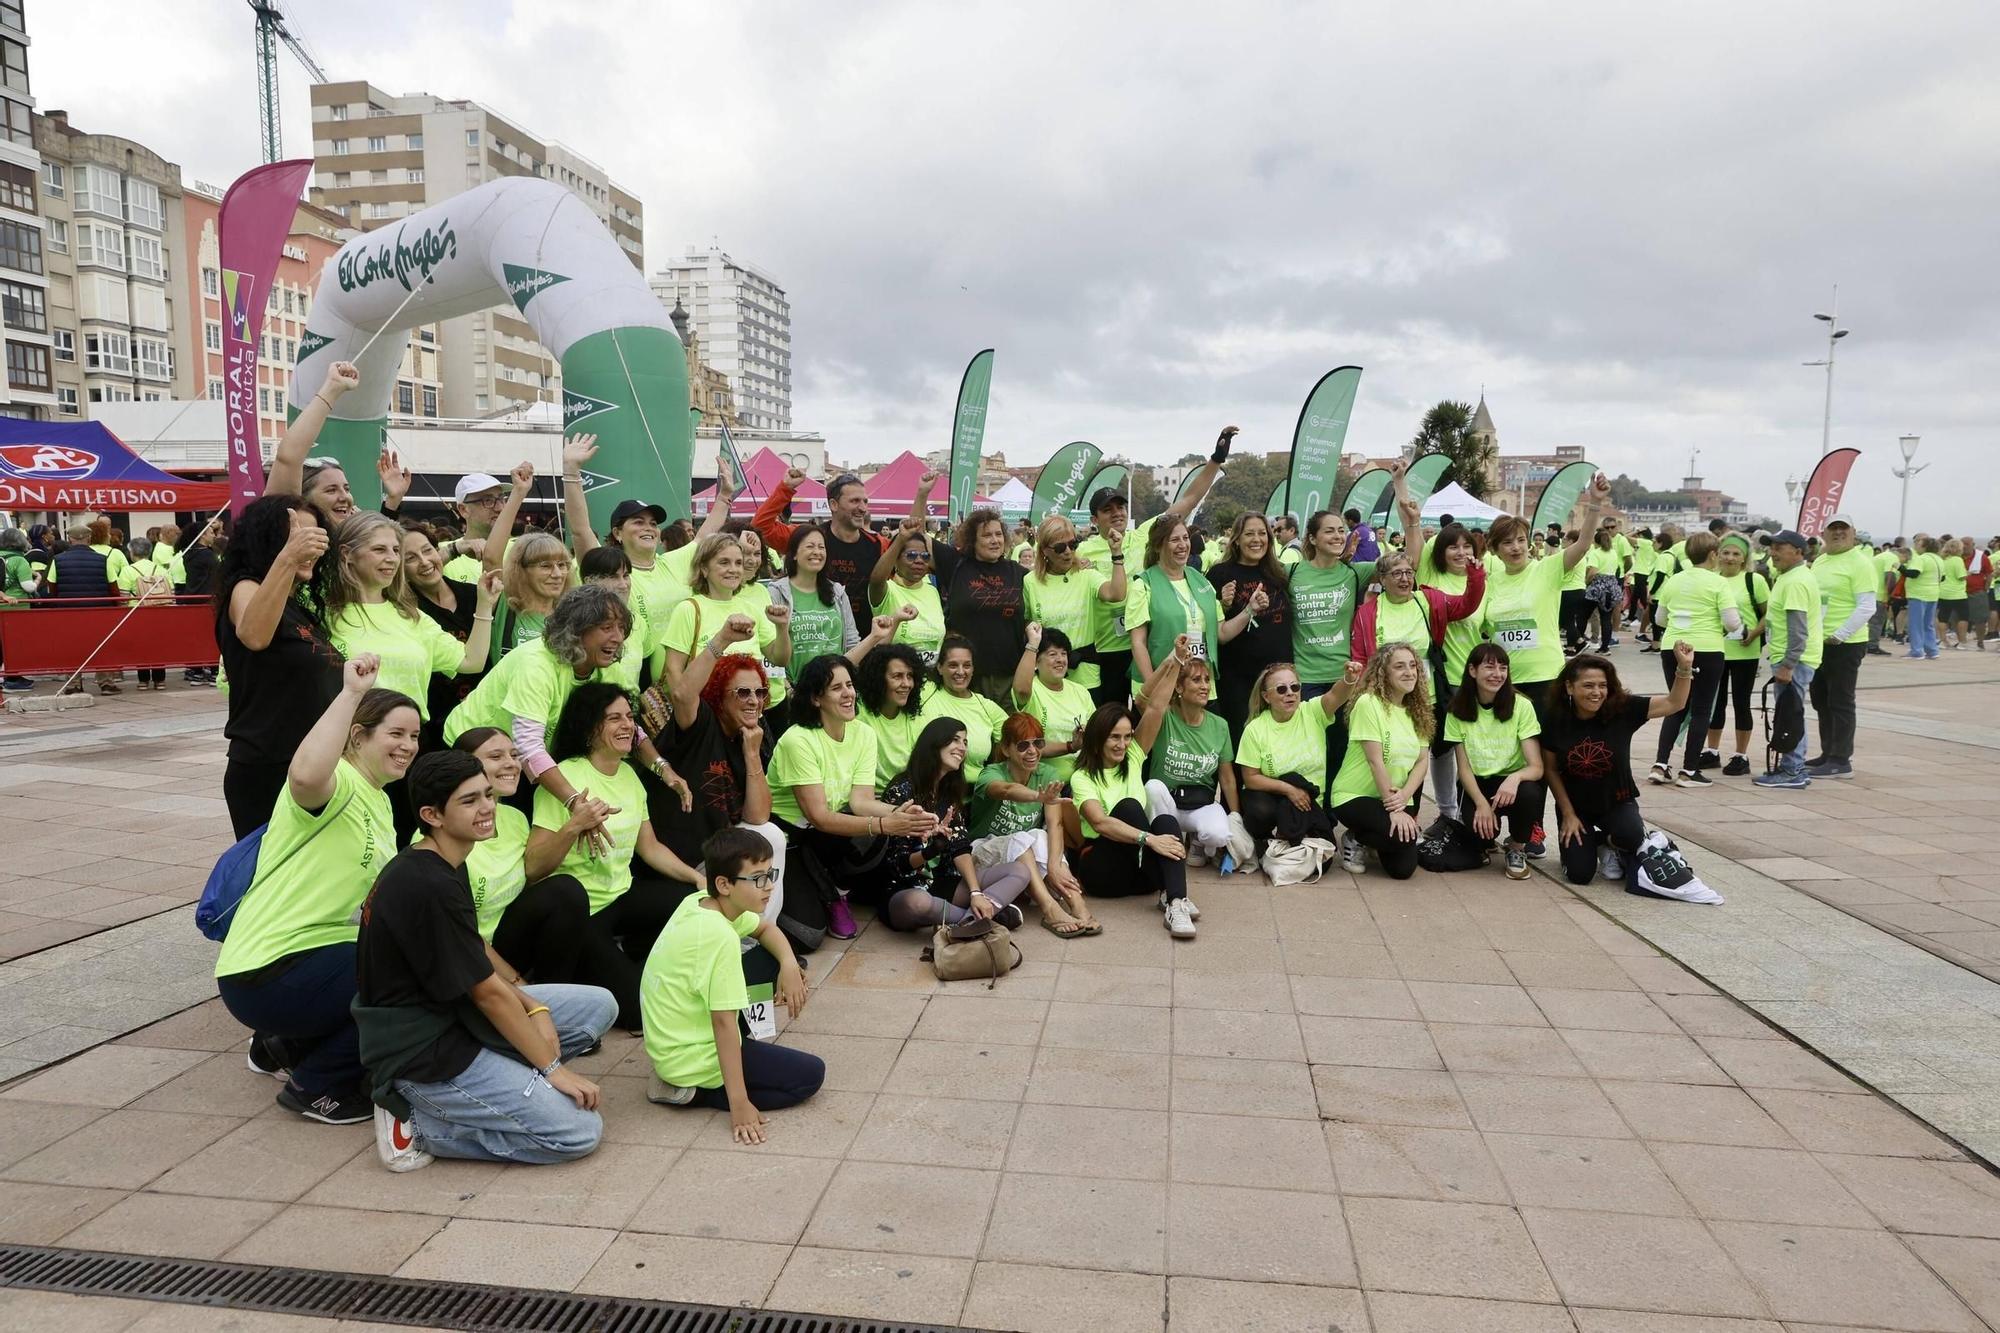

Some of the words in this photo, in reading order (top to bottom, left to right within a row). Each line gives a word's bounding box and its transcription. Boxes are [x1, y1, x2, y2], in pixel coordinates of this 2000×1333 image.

[338, 250, 356, 293] El
[354, 246, 394, 287] Corte
[395, 217, 457, 292] Inglés
[243, 349, 255, 415] kutxa
[56, 489, 177, 505] ATLETISMO
[1297, 601, 1326, 610] contra
[1306, 608, 1339, 618] cáncer
[791, 623, 817, 632] contra
[1501, 630, 1531, 642] 1052
[1167, 745, 1179, 758] En
[1164, 757, 1194, 770] contra
